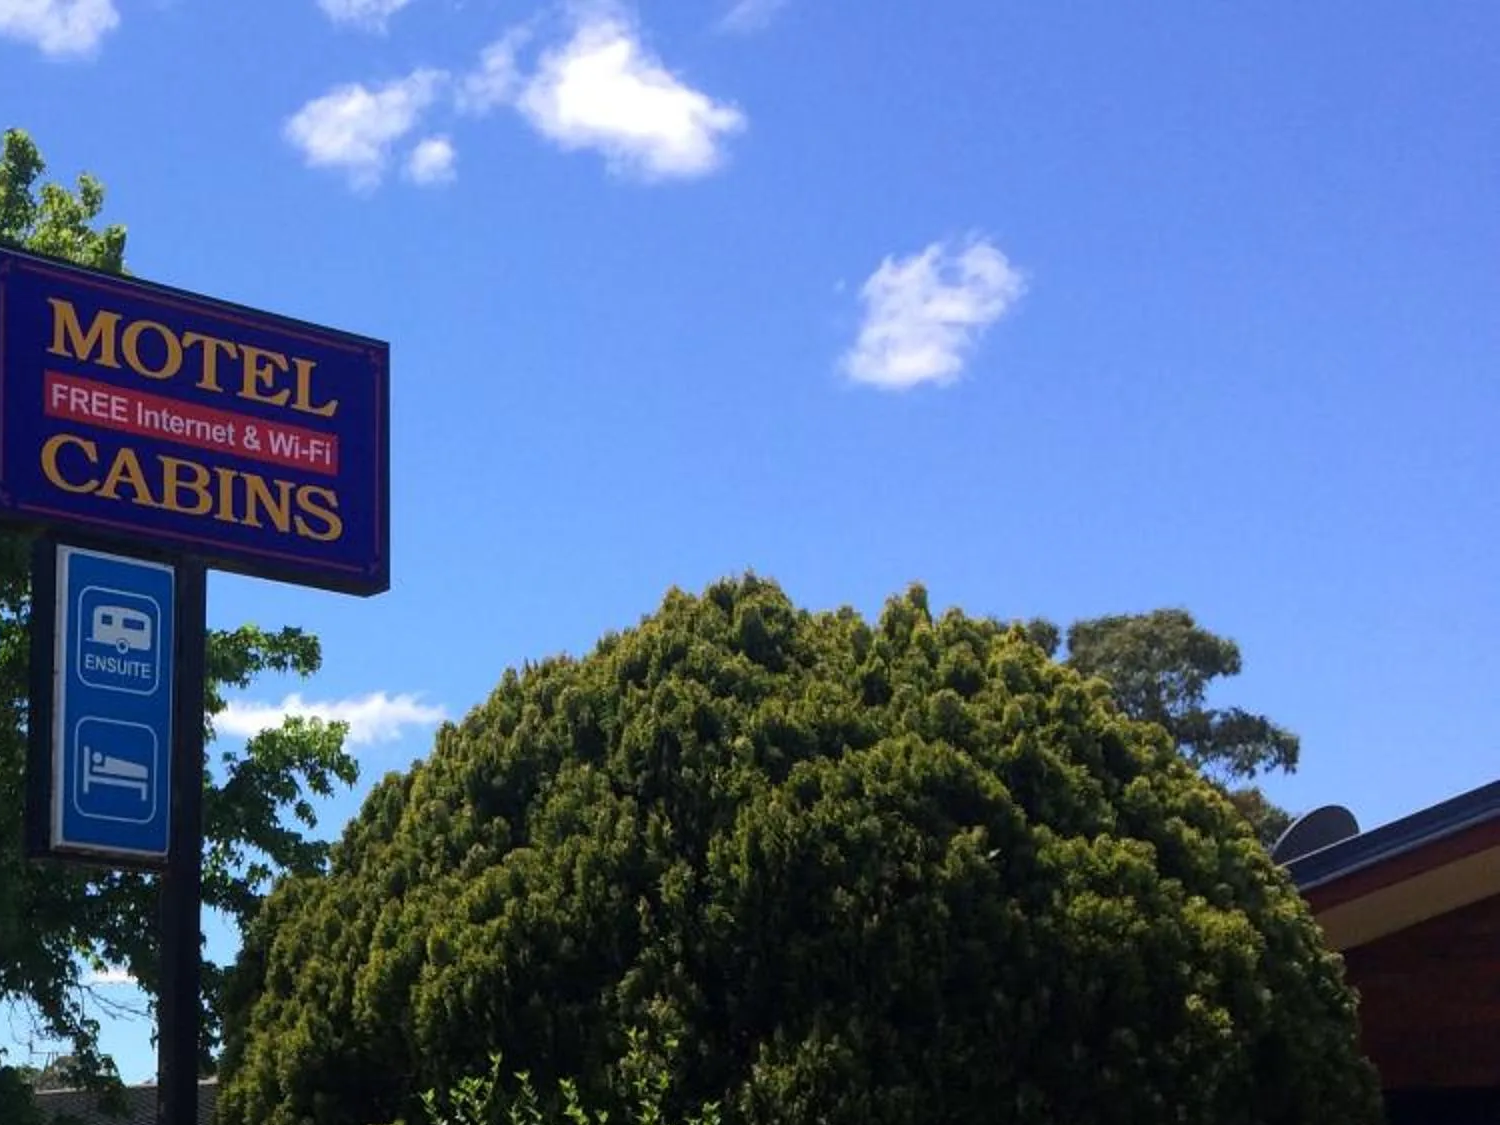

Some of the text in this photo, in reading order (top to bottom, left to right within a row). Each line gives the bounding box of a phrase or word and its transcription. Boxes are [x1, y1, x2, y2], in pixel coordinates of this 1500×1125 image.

[47, 298, 339, 417] MOTEL
[51, 383, 332, 466] FREE Internet & Wi-Fi
[41, 433, 342, 542] CABINS
[84, 653, 151, 679] ENSUITE
